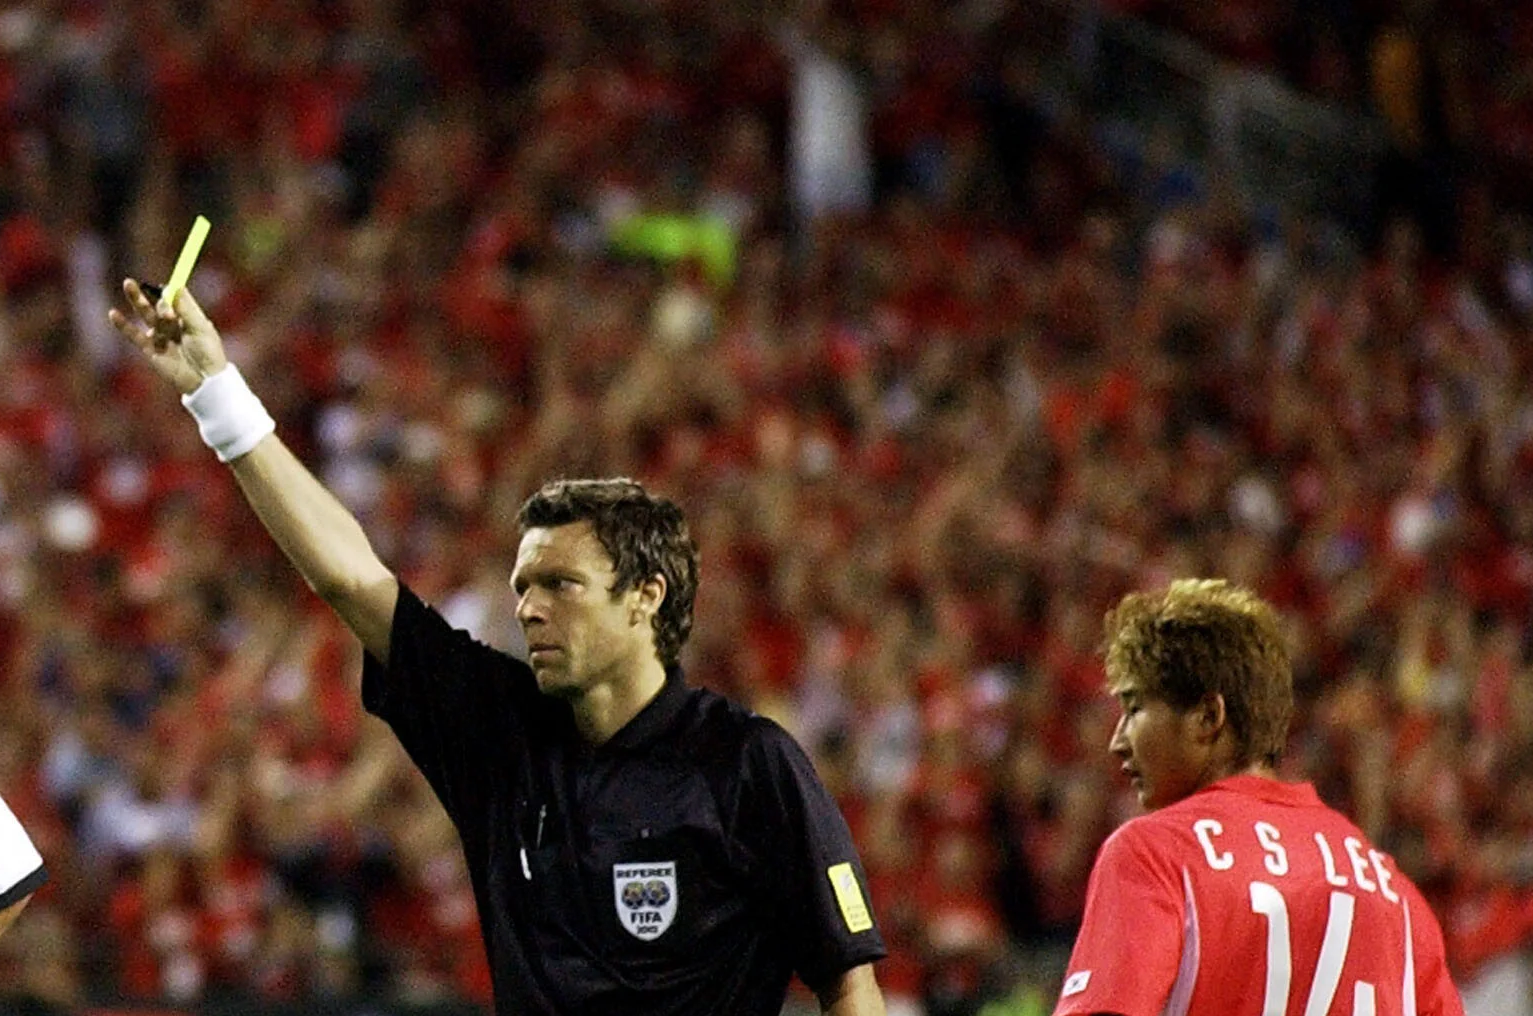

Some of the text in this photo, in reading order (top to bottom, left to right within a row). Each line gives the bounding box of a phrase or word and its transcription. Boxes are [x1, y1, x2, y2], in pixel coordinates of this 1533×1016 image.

[1193, 819, 1399, 904] C S LEE
[630, 911, 663, 924] FIFA
